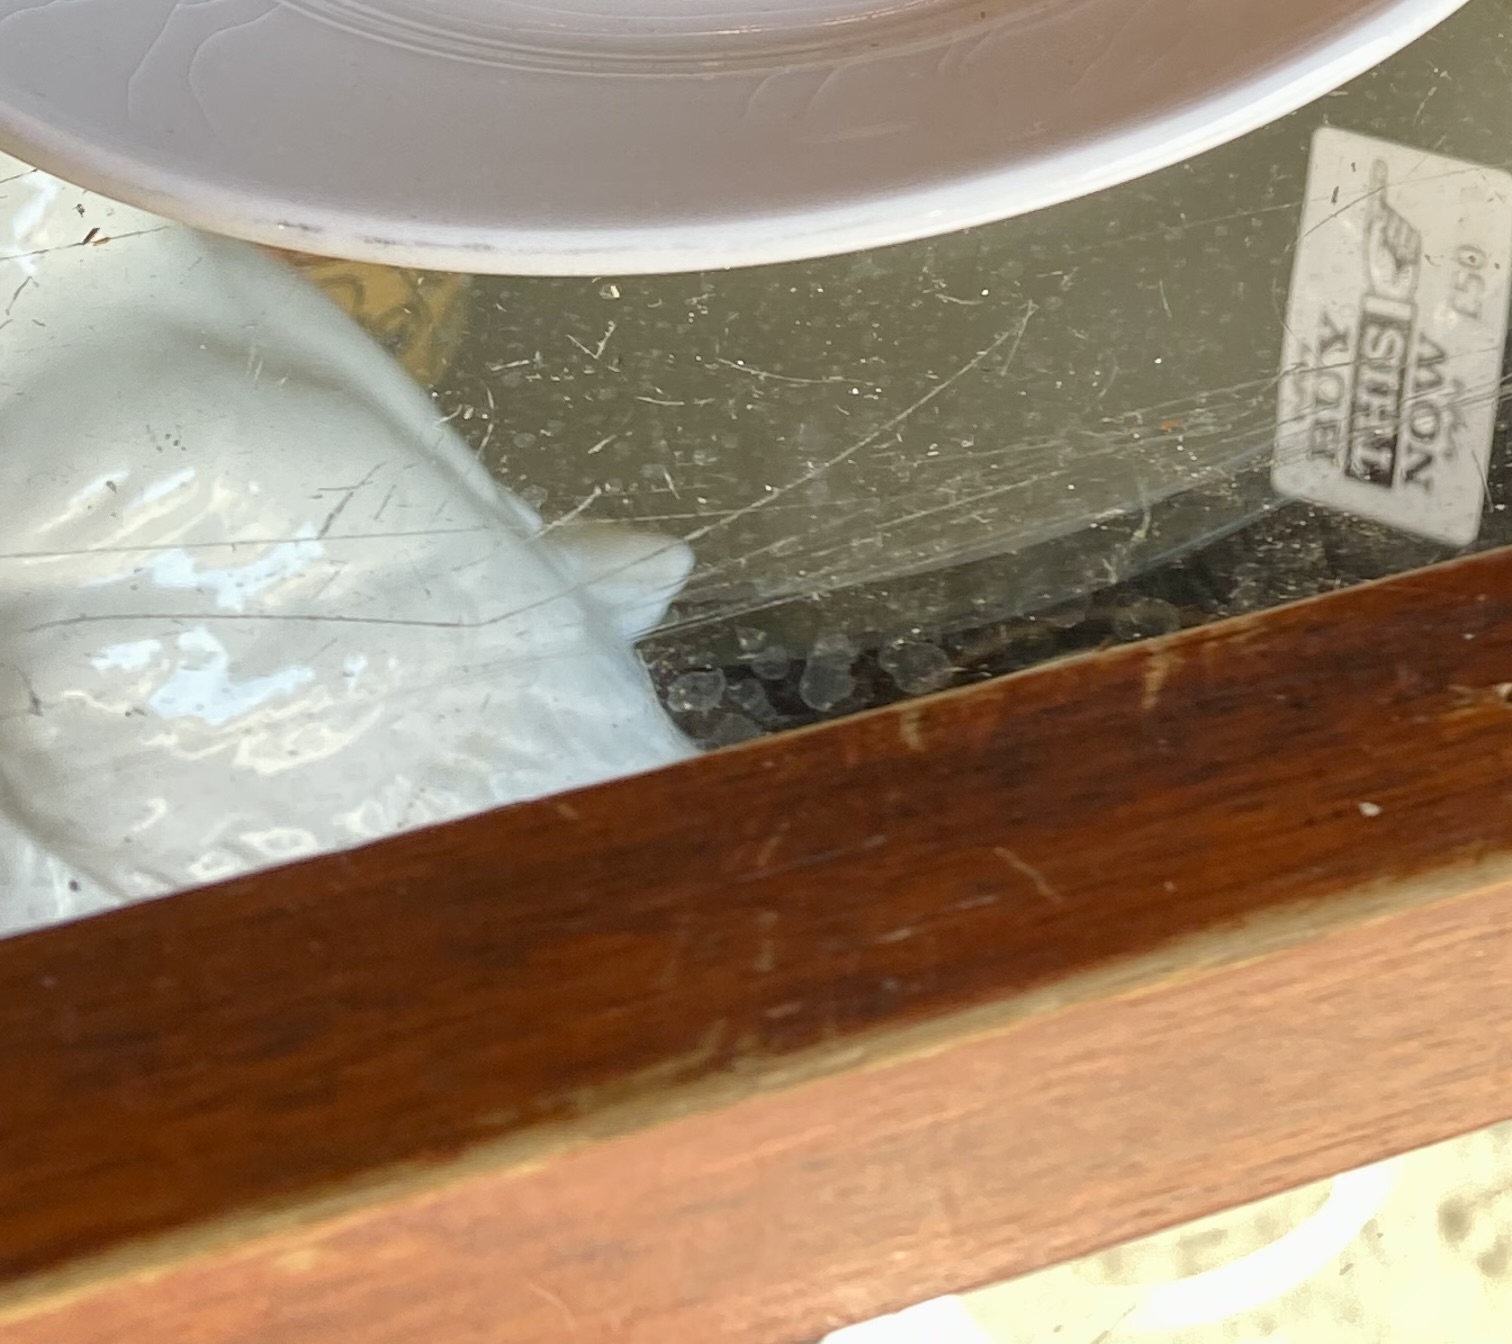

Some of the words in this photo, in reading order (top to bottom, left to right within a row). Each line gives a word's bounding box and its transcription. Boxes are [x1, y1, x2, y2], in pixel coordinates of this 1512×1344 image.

[1311, 311, 1348, 460] BUY
[1357, 324, 1404, 472] THIS
[1403, 335, 1446, 491] NOW
